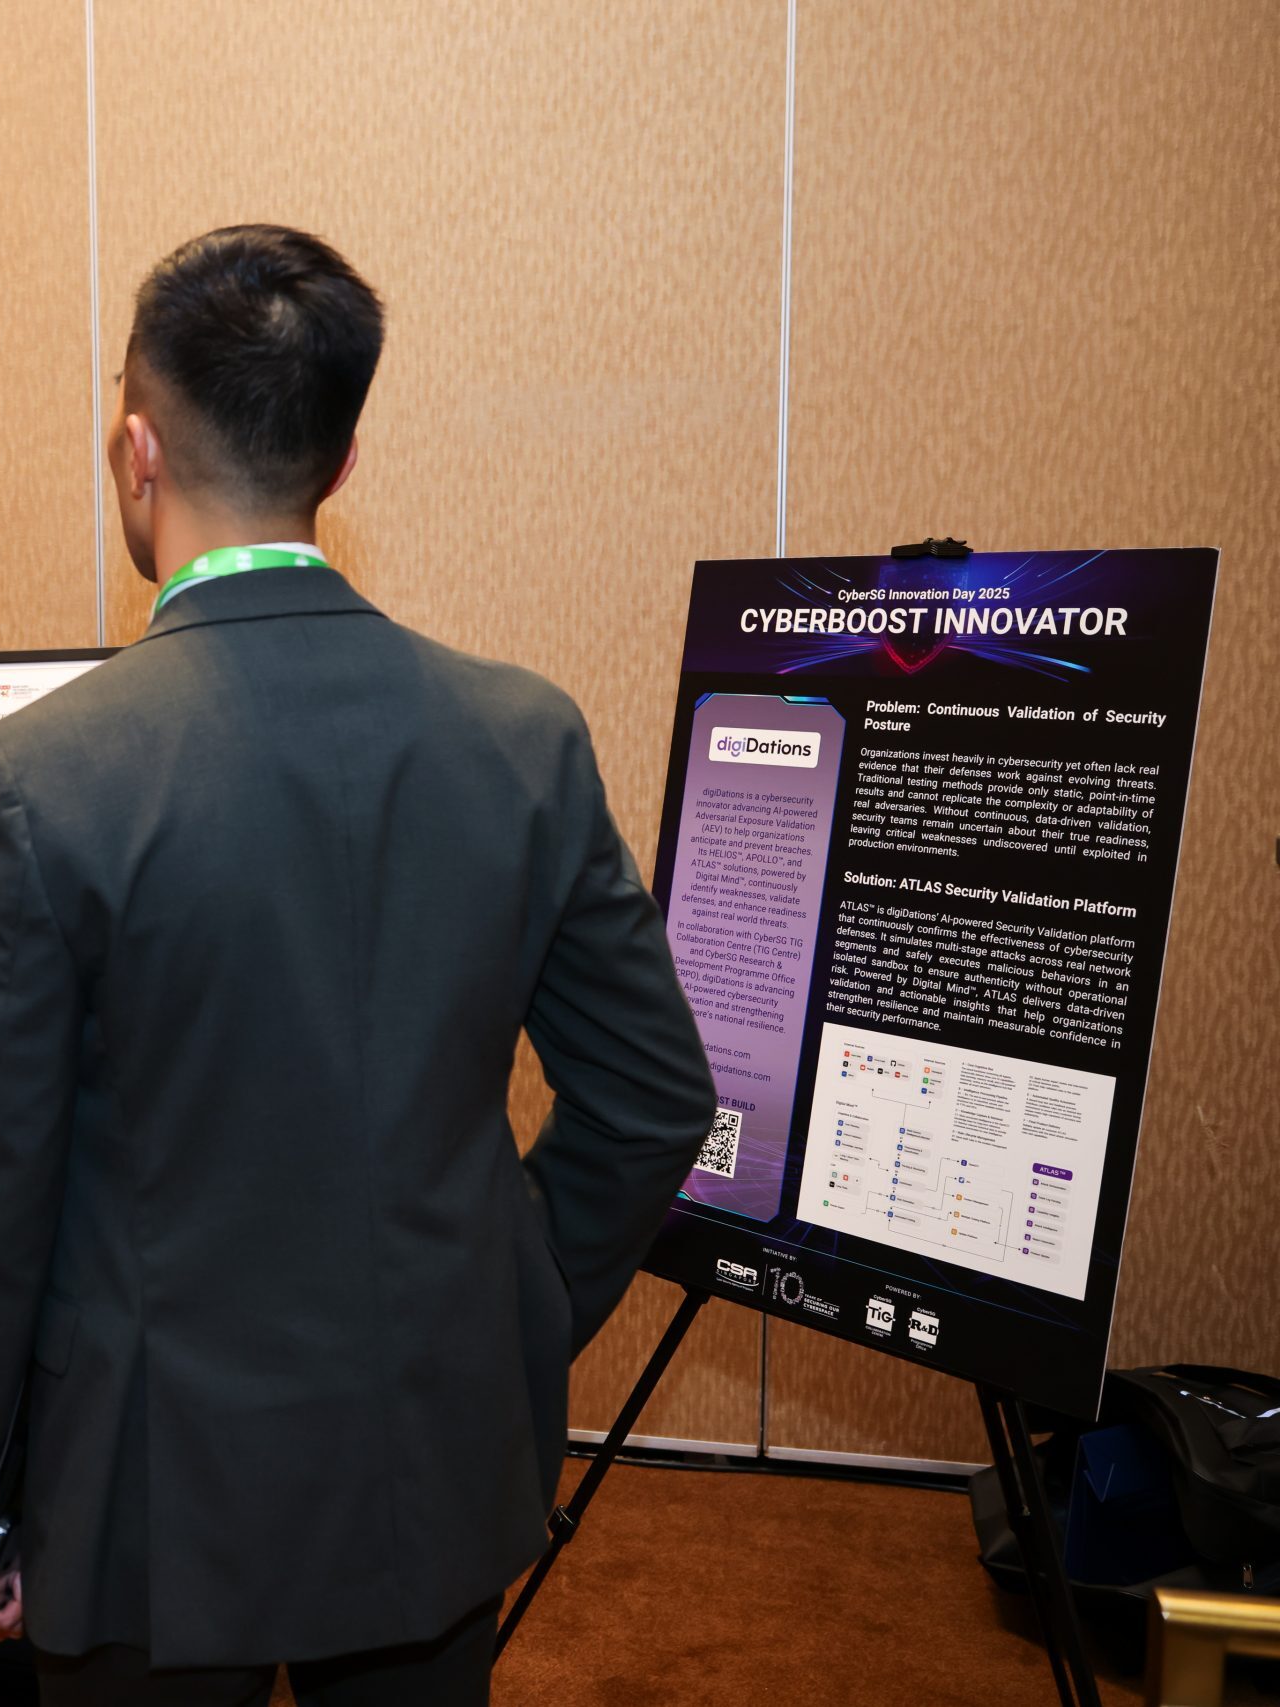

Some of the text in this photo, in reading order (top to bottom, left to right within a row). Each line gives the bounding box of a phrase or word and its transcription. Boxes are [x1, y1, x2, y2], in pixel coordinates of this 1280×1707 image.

[837, 586, 1010, 603] CyberSG Innovation Day 2025
[740, 606, 1128, 638] CYBERBOOST INNOVATOR
[863, 717, 911, 732] Posture
[866, 700, 1166, 728] Problem: Continuous Validation of Security
[716, 735, 812, 757] digiDations
[860, 747, 1159, 775] Organizations invest heavily in cybersecurity yet often lack real
[858, 760, 1156, 789] evidence that their defenses work against evolving threats.
[702, 787, 745, 799] digiDations
[745, 791, 753, 800] is
[760, 792, 814, 807] cybersecurity
[857, 772, 1155, 804] Traditional testing methods provide only static, point-in-time
[695, 798, 818, 819] innovator advancing AI-powered
[855, 786, 884, 796] results
[887, 788, 904, 798] and
[907, 791, 938, 801] cannot
[942, 793, 982, 804] replicate
[985, 795, 1001, 806] the
[1004, 799, 1058, 813] complexity
[1076, 803, 1138, 819] adaptability
[1141, 808, 1154, 818] of
[694, 810, 815, 831] Adversarial Exposure Validation
[853, 799, 1150, 834] real adversaries. Without continuous, data-driven validation,
[701, 822, 806, 843] (AEV) to help organizations
[851, 812, 1148, 848] security teams remain uncertain about their true readiness,
[848, 838, 959, 856] production environments.
[850, 823, 1147, 862] leaving critical weaknesses undiscovered until exploited in
[843, 870, 1136, 918] Solution: ATLAS Security Validation Platform
[676, 920, 803, 948] In collaboration with CyberSG TIG
[876, 904, 884, 914] is
[940, 913, 993, 929] AI-powered
[995, 920, 1035, 936] Security
[1037, 926, 1087, 942] Validation
[1089, 933, 1135, 948] platform
[675, 932, 801, 962] Collaboration Centre (TIG Centre)
[838, 912, 1133, 965] that continuously confirms the effectiveness of cybersecurity
[704, 1043, 751, 1060] dations.com
[710, 1062, 771, 1082] digidations.com
[731, 1099, 756, 1111] BUILD
[716, 1258, 758, 1281] CSA
[885, 1284, 912, 1297] POWERED
[868, 1306, 894, 1323] TiG
[910, 1318, 939, 1336] R&D
